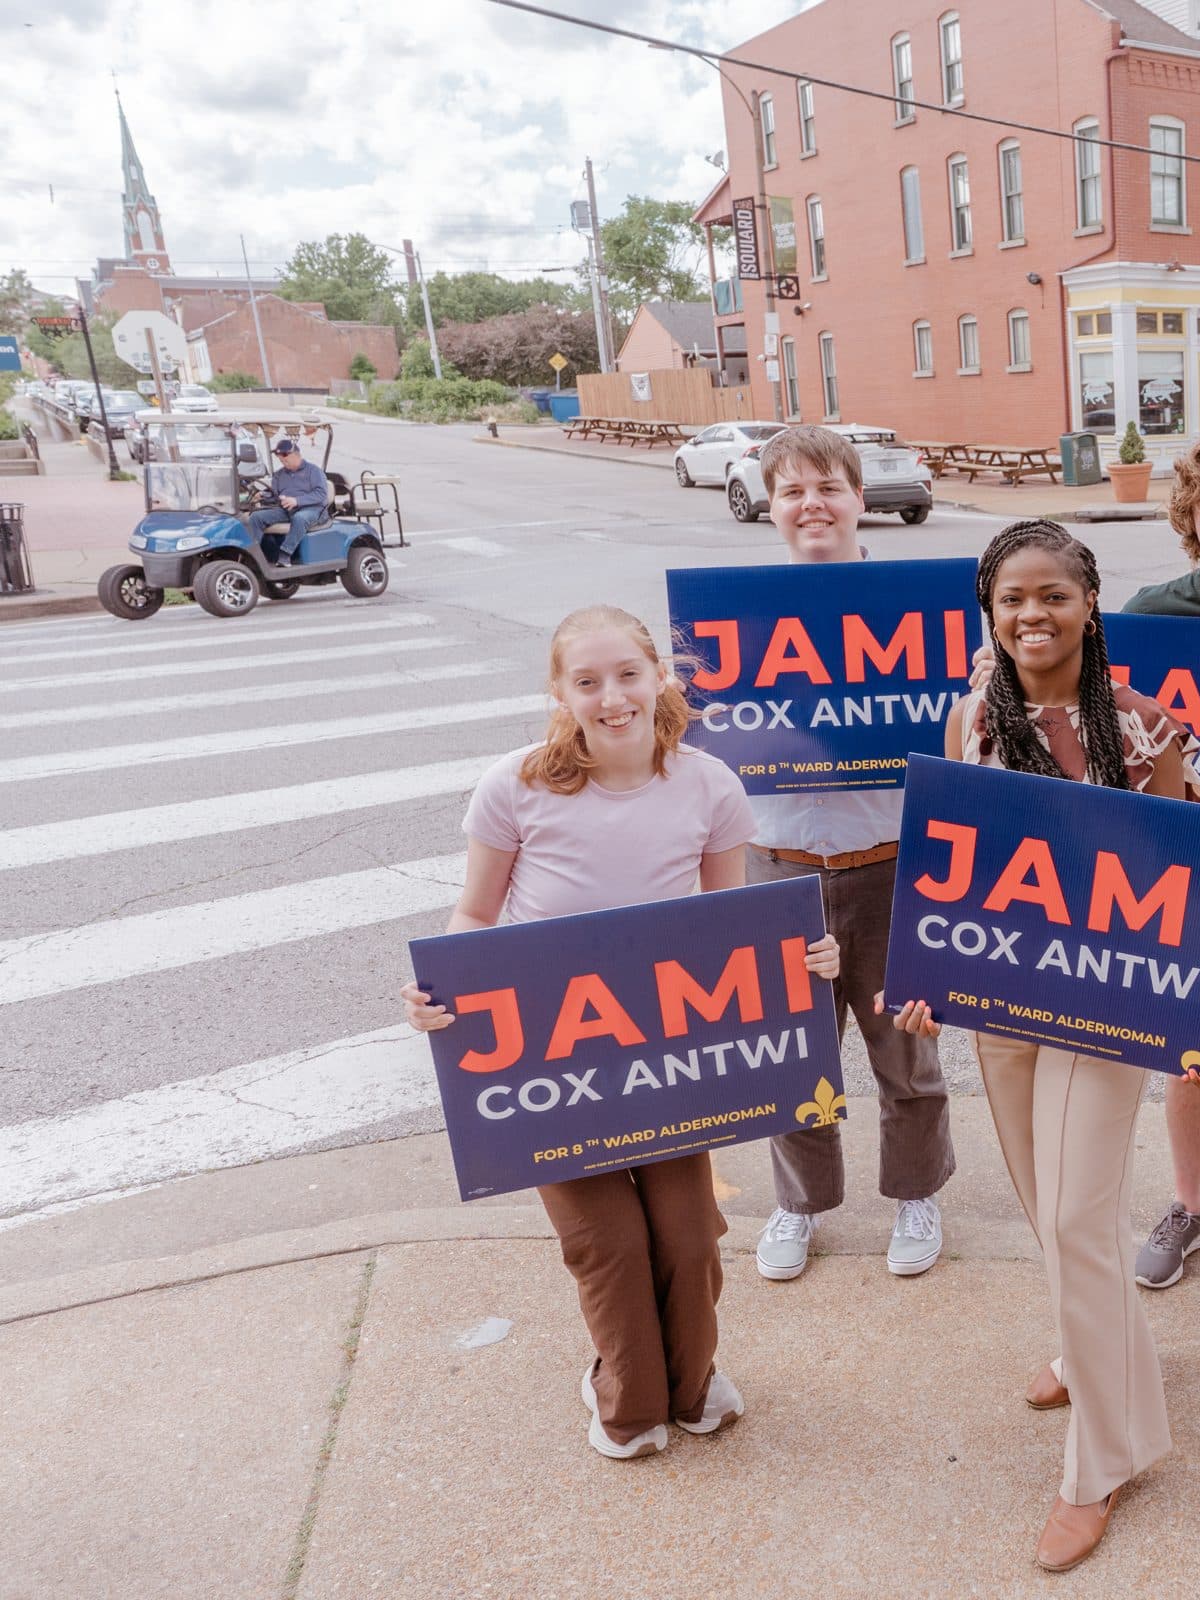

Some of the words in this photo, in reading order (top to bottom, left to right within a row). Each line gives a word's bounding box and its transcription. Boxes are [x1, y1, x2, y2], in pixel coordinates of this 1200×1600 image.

[737, 210, 757, 272] SOULARD
[689, 609, 968, 691] JAMI
[701, 700, 795, 733] COX
[739, 764, 766, 776] FOR
[768, 764, 777, 775] 8
[792, 761, 833, 774] WARD
[917, 914, 1023, 966] COX
[454, 936, 815, 1074] JAMI
[948, 991, 978, 1008] FOR
[980, 997, 990, 1010] 8
[993, 998, 1005, 1008] TH
[1007, 1003, 1054, 1023] WARD
[1056, 1013, 1166, 1049] ALDERWOMAN
[476, 1067, 603, 1121] COX
[621, 1027, 810, 1097] ANTWI
[533, 1145, 569, 1164] FOR
[572, 1143, 584, 1156] 8
[585, 1138, 599, 1148] TH
[603, 1129, 656, 1149] WARD
[659, 1103, 777, 1138] ALDERWOMAN
